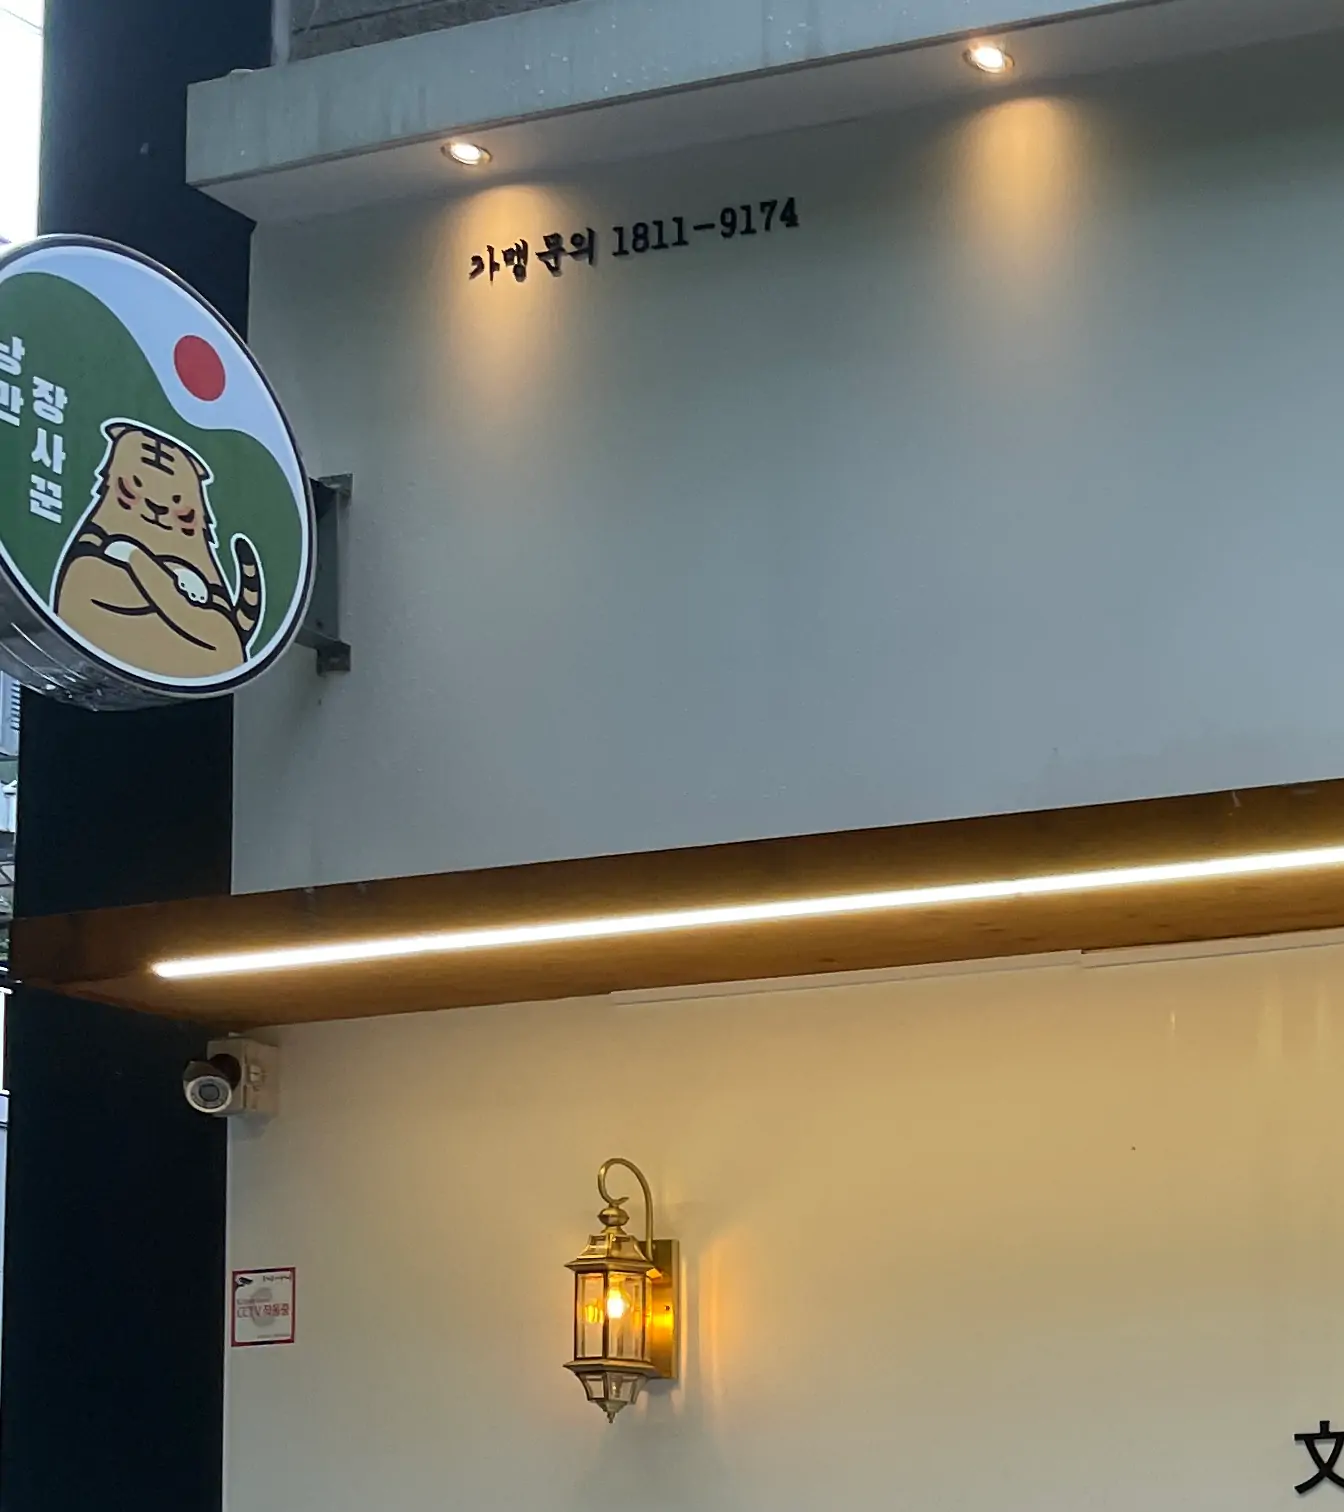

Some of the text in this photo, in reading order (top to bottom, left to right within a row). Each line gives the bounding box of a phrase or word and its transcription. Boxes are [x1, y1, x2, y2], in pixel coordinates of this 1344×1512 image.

[469, 196, 800, 284] 가맹 문의 1811-9174
[30, 375, 68, 525] 장사꾼
